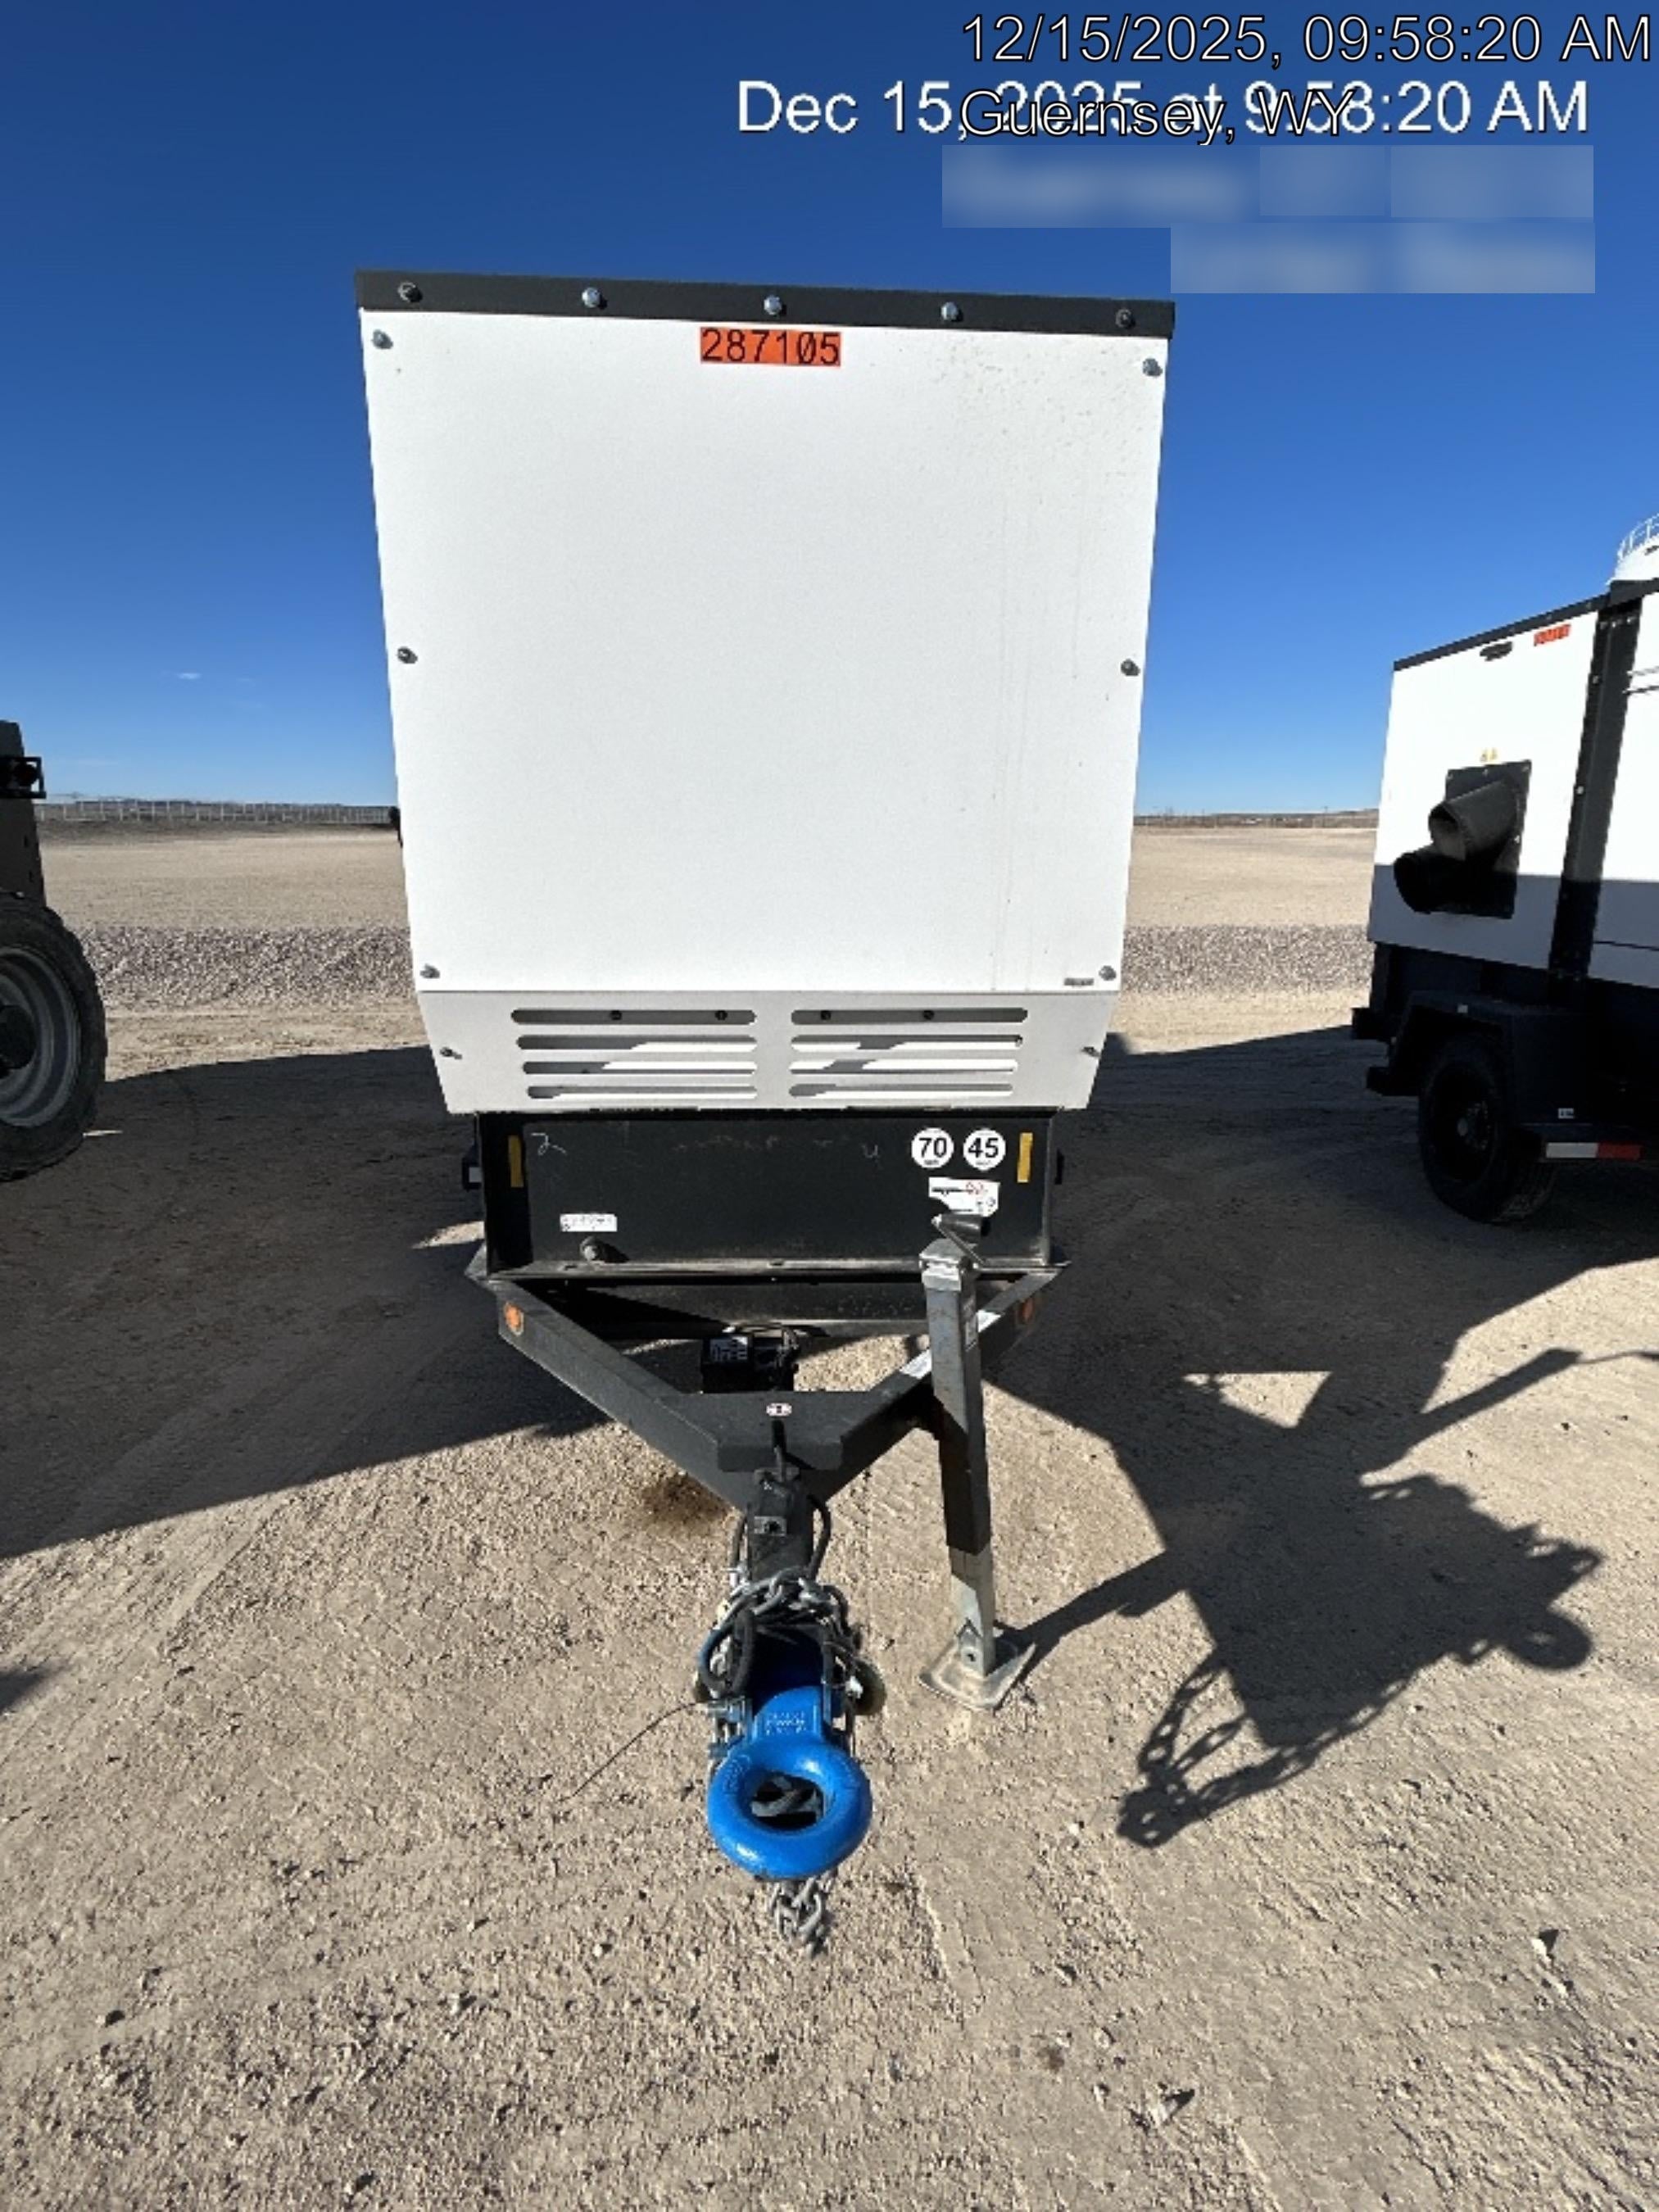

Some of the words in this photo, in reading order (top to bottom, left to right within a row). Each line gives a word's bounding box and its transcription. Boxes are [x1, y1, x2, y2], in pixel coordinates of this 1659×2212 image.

[702, 329, 840, 364] 287105
[918, 1136, 947, 1158] 70
[968, 1137, 999, 1158] 45
